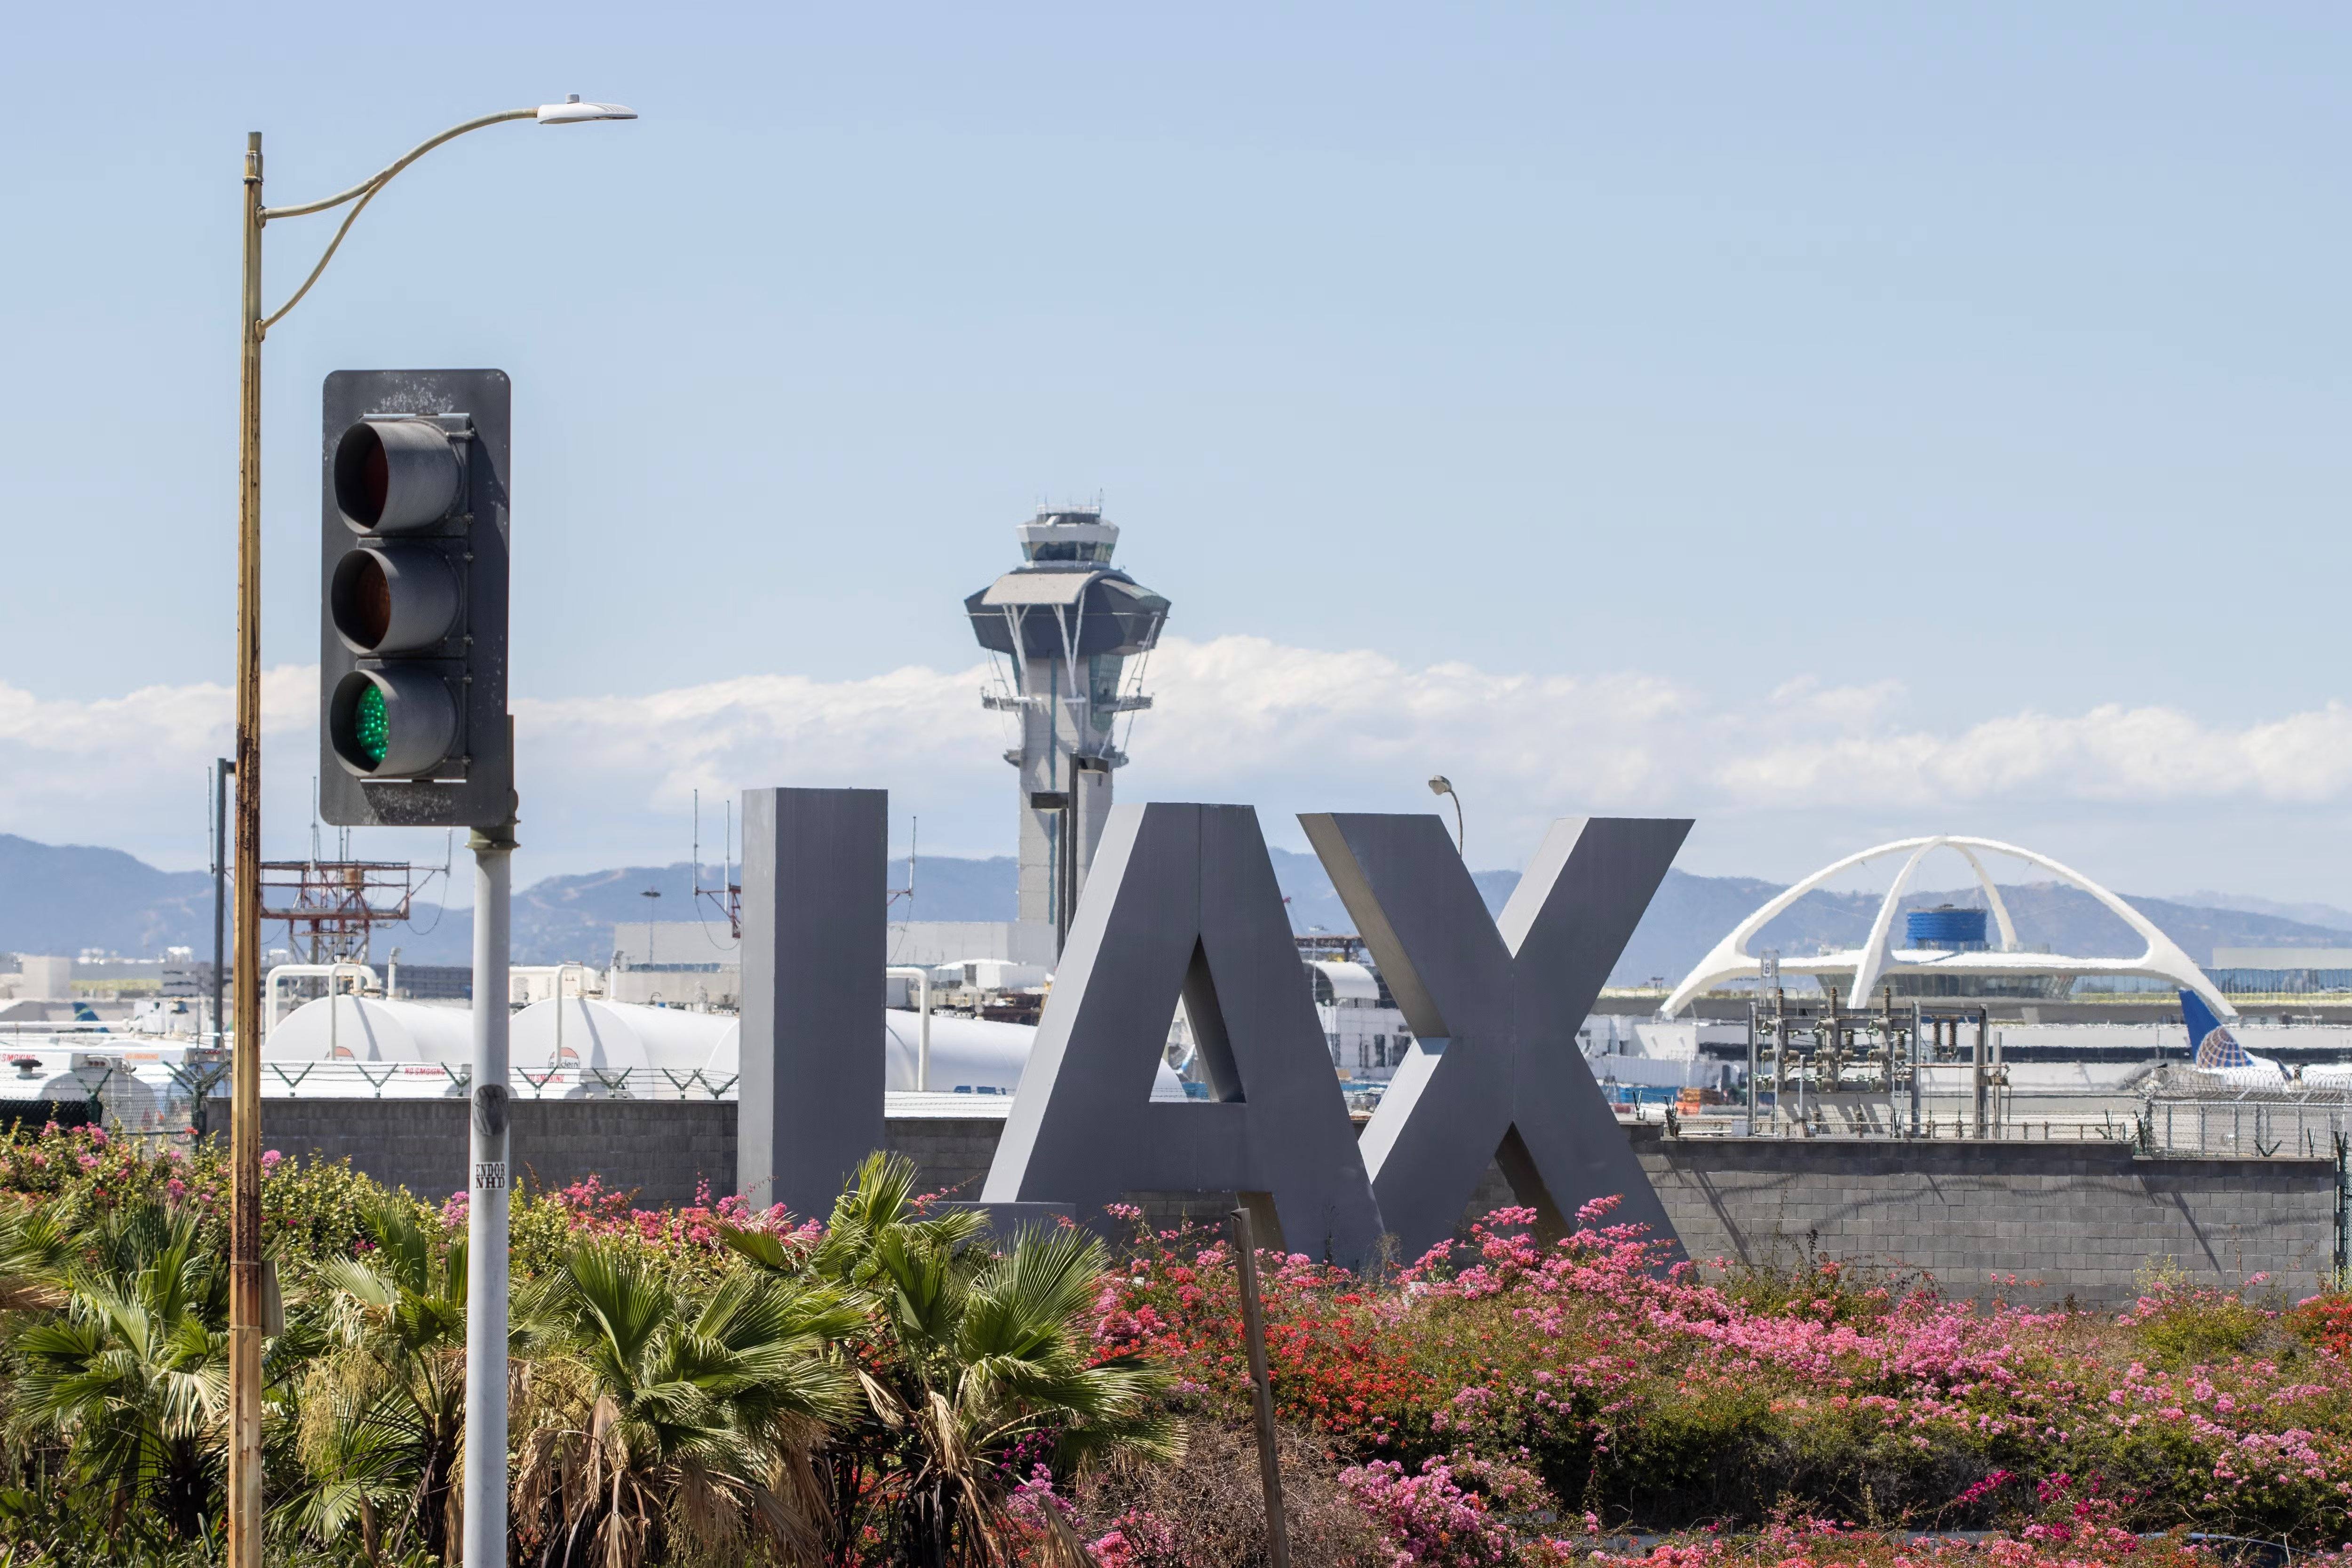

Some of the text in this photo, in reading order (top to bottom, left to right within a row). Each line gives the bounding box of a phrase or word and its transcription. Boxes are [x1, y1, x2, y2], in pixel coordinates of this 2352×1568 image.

[737, 787, 1696, 1279] LAX
[549, 1059, 579, 1068] mdern
[414, 1068, 445, 1076] SMOKING
[475, 1163, 505, 1177] ENDOR
[475, 1176, 505, 1189] NHD
